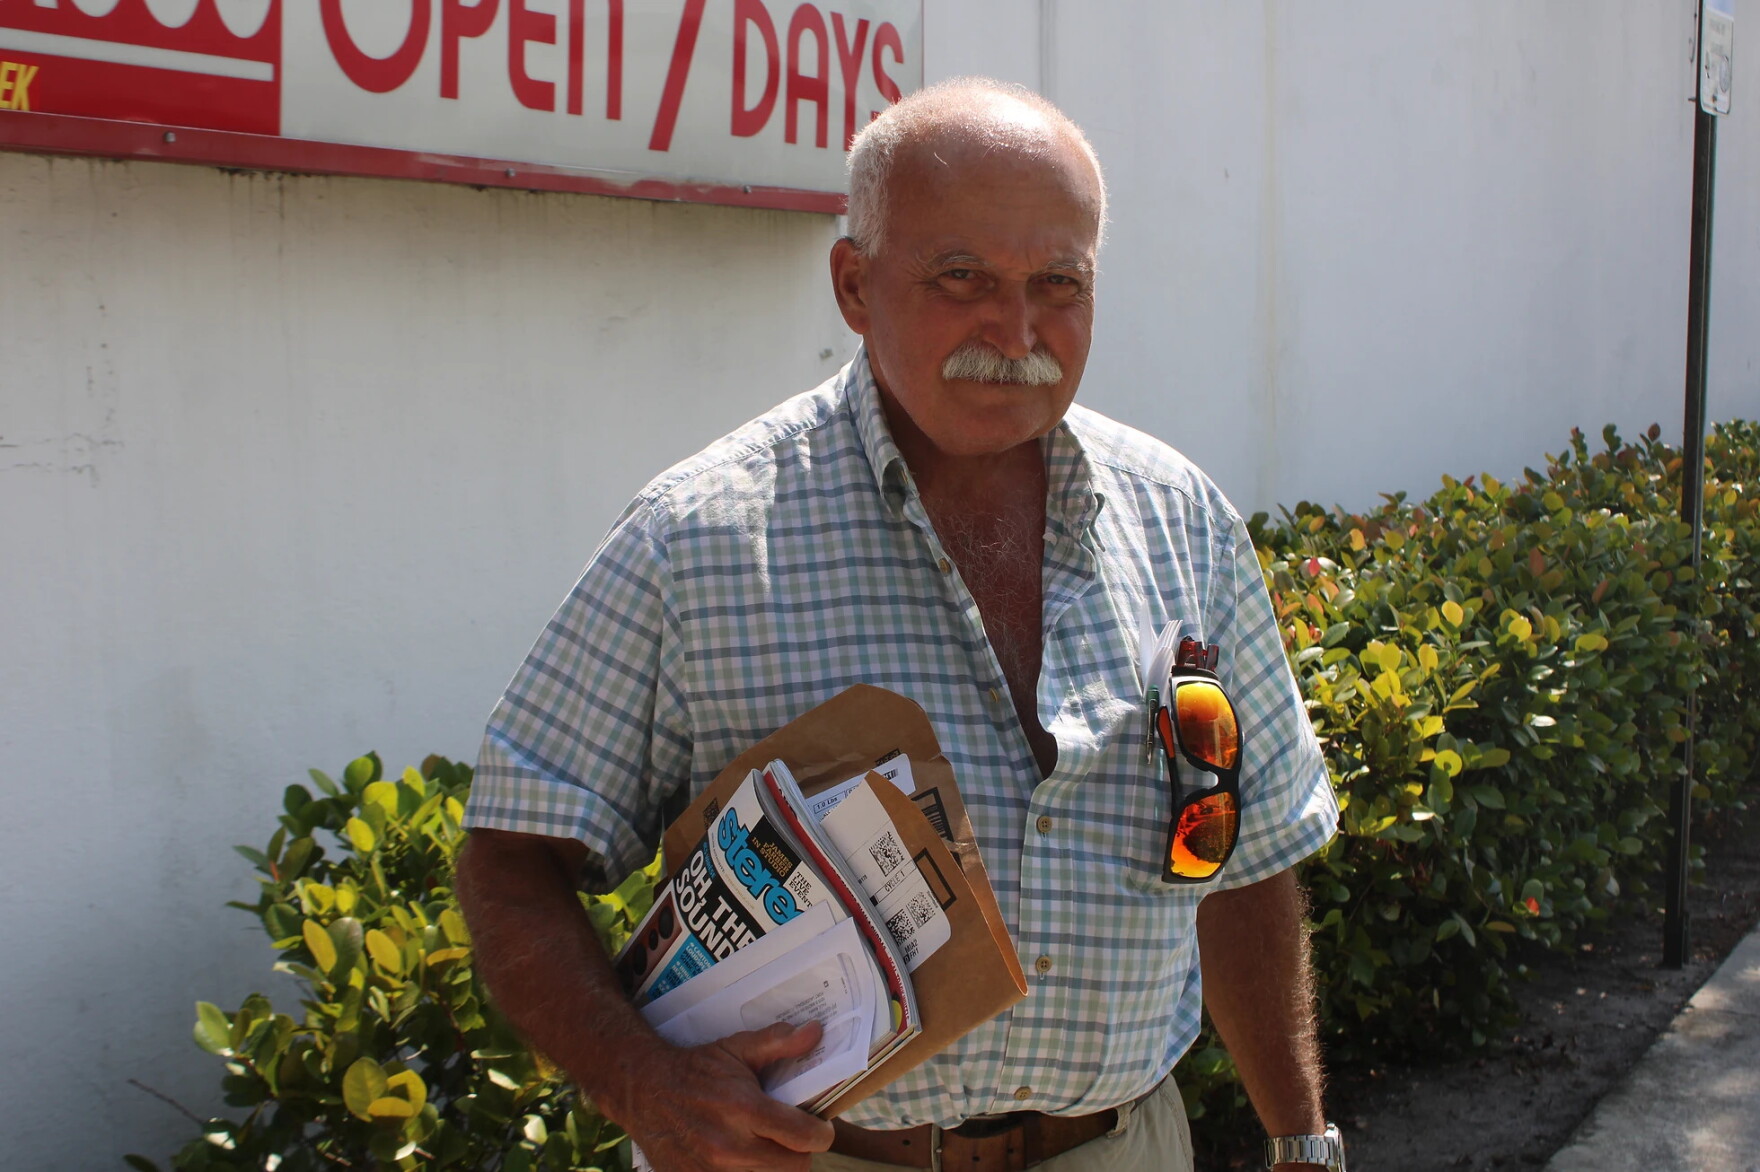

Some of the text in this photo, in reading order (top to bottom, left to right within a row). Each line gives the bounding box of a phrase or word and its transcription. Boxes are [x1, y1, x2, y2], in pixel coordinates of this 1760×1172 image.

[731, 0, 904, 152] DAYS
[718, 807, 805, 925] stere
[751, 837, 786, 878] IN STUDIO
[763, 842, 790, 874] FARBER
[769, 842, 793, 869] JAMES
[690, 850, 713, 907] OH,
[789, 881, 813, 908] EVENT
[792, 876, 809, 895] LIVE
[797, 871, 812, 890] THE
[884, 872, 901, 892] CYCLE
[676, 868, 736, 960] SOUND
